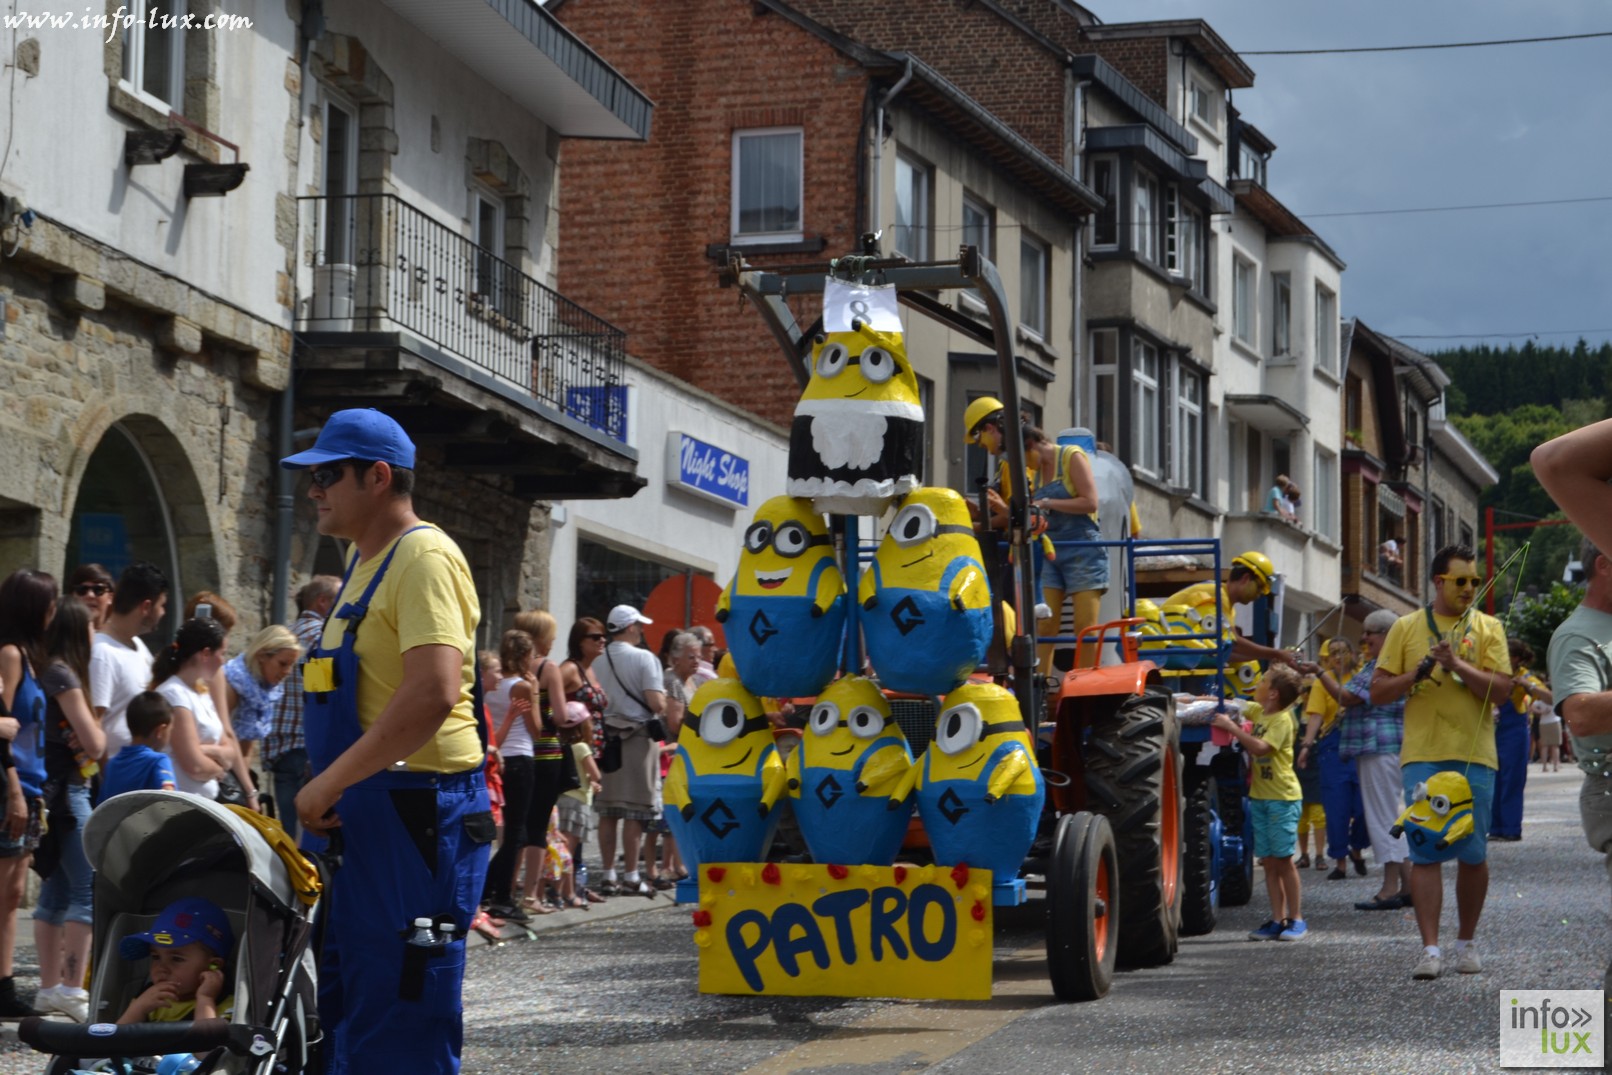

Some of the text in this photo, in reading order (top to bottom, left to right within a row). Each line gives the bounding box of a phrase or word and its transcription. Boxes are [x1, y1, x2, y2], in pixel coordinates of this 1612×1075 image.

[849, 300, 872, 327] 8
[681, 436, 748, 500] Night Shop
[725, 883, 957, 993] PATRO
